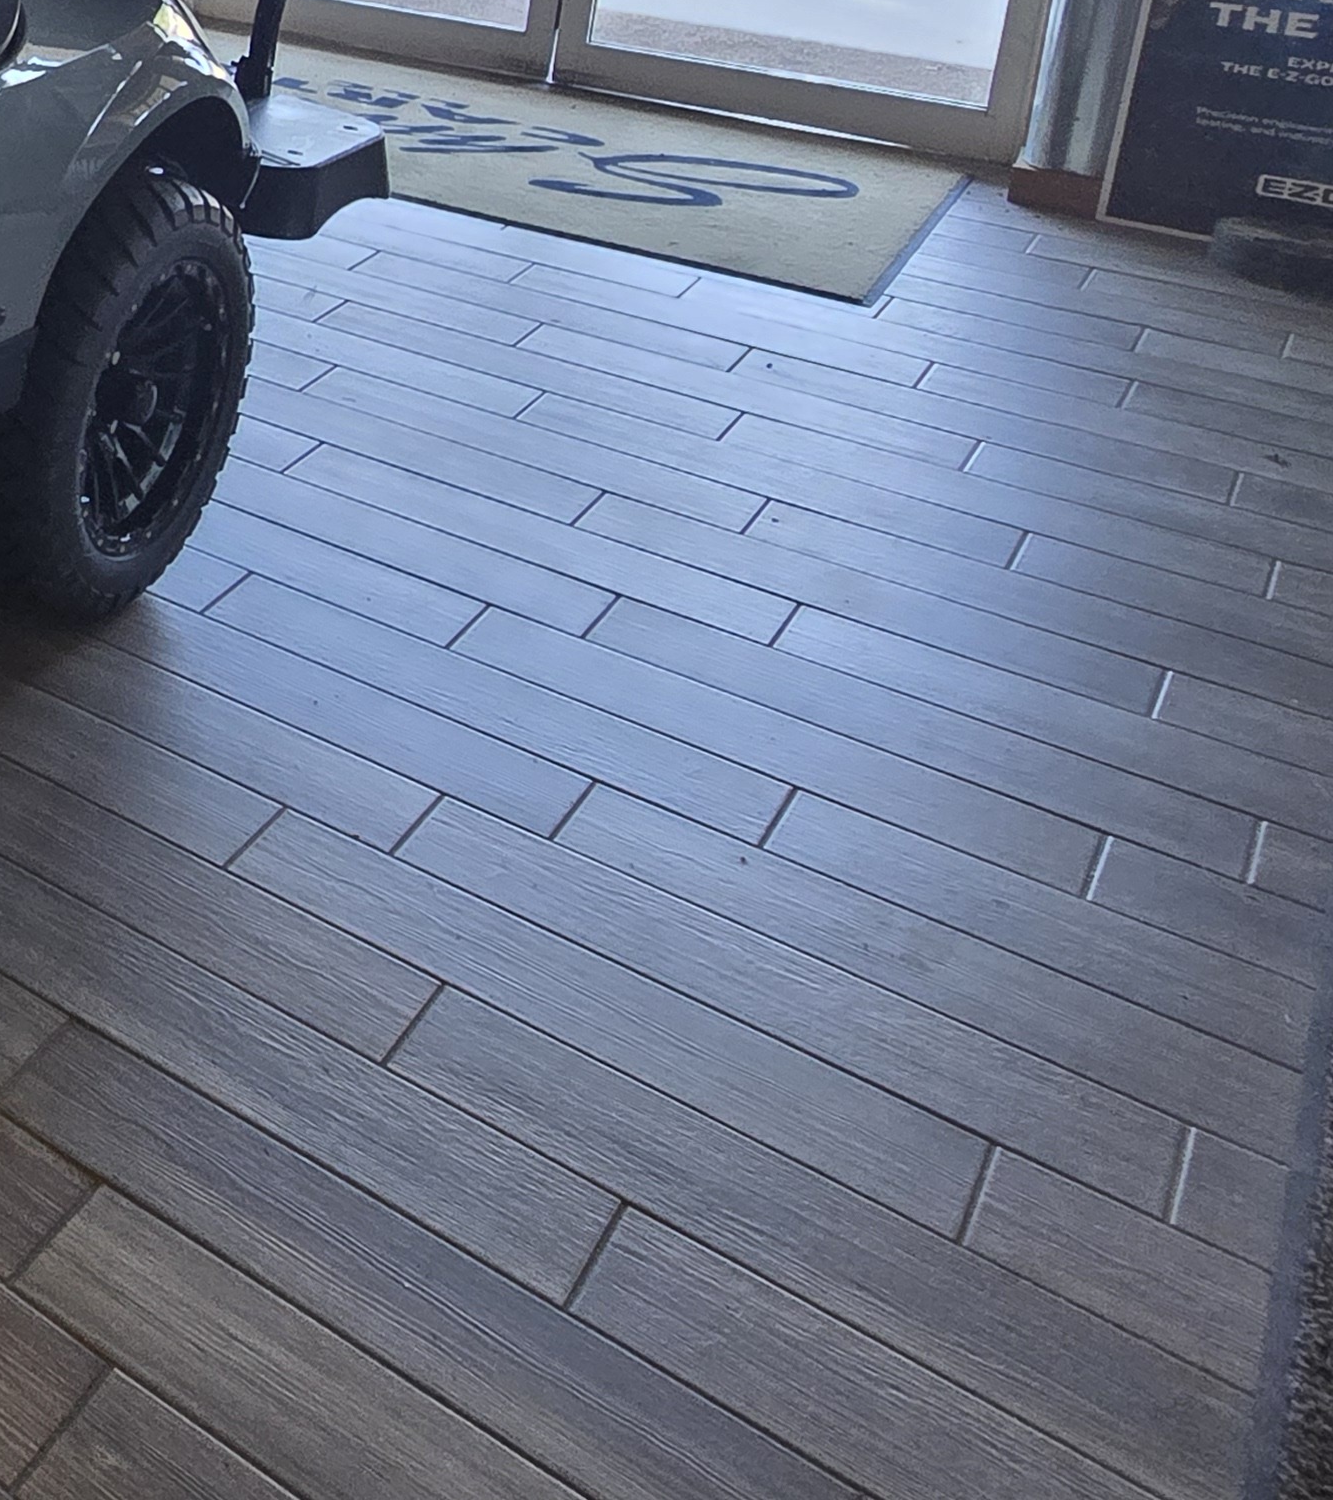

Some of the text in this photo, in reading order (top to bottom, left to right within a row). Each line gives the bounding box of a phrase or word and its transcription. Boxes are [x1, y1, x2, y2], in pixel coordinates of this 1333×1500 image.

[1209, 1, 1320, 40] THE
[1221, 61, 1263, 77] THE
[1288, 56, 1333, 73] EXP
